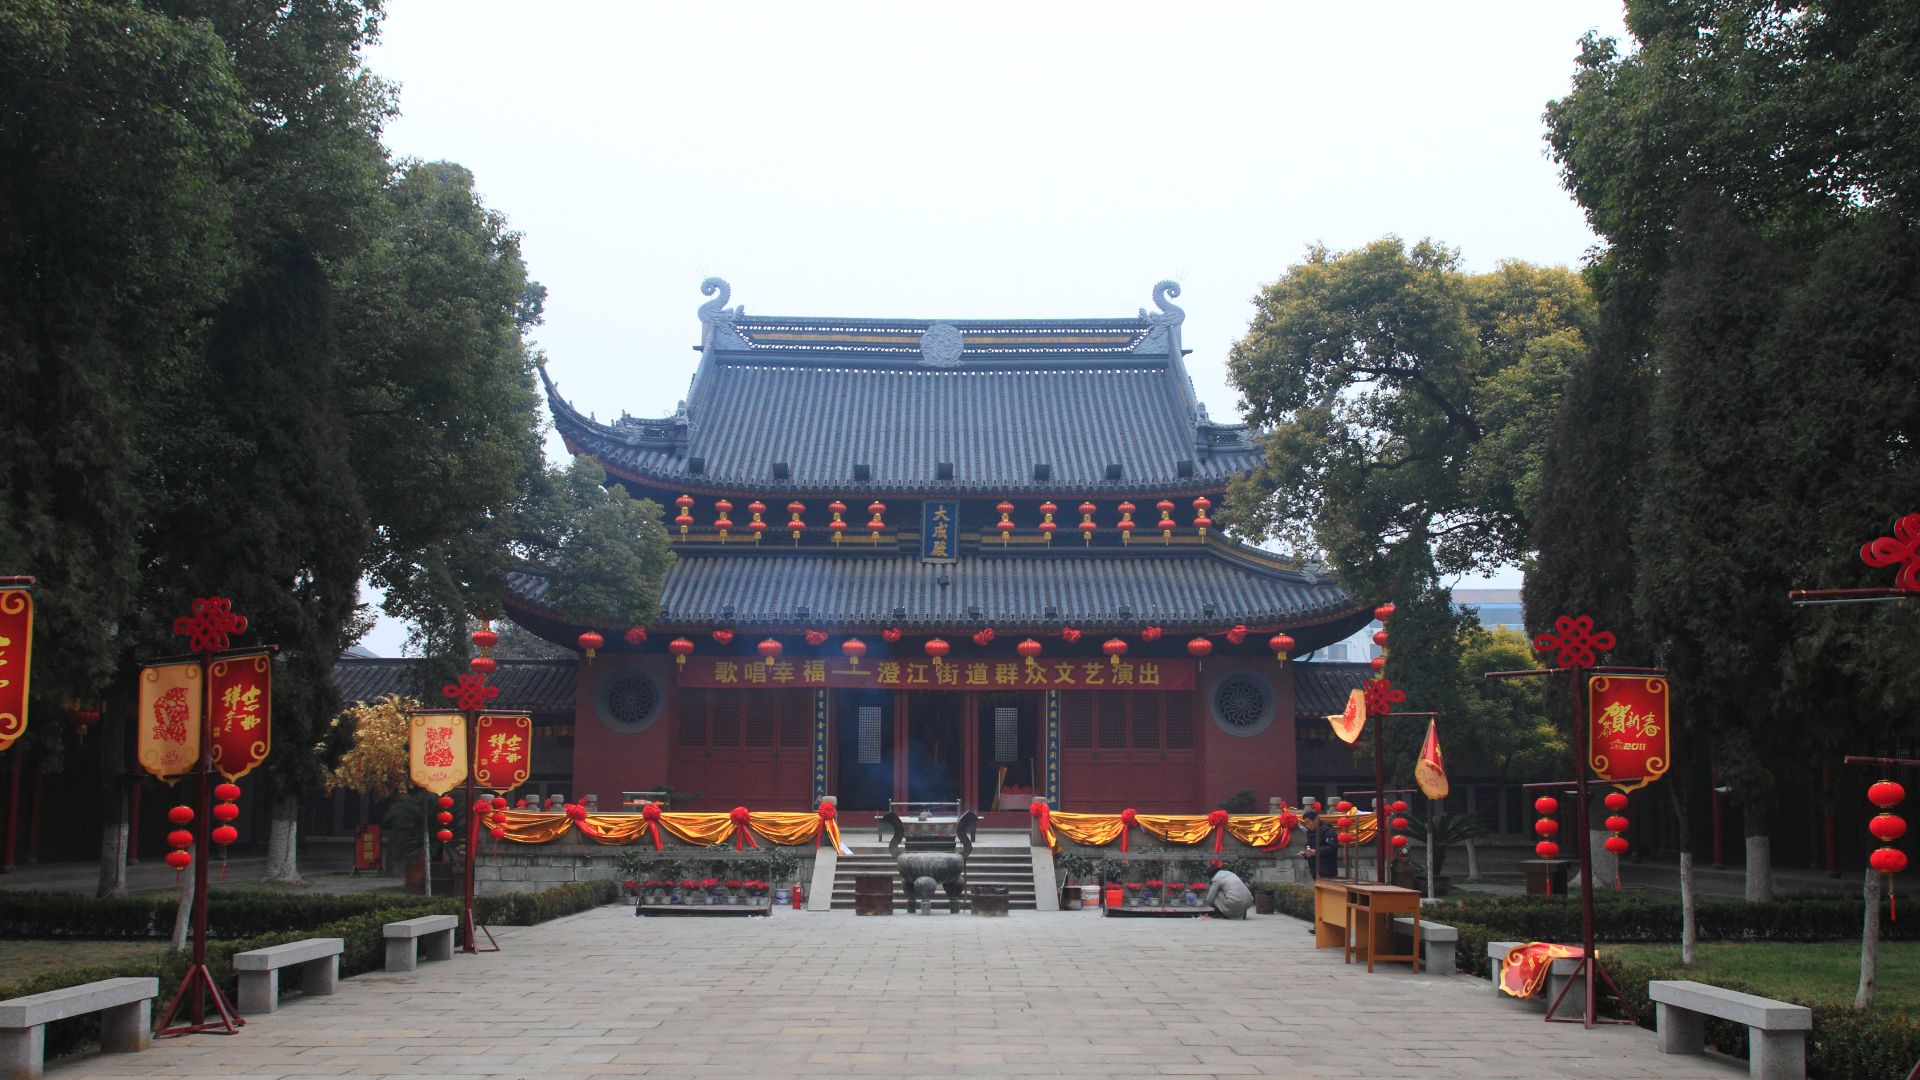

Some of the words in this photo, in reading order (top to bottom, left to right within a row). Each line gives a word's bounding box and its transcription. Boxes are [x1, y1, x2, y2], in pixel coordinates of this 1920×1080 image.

[932, 505, 951, 557] 大成殿
[1623, 743, 1646, 751] 2011
